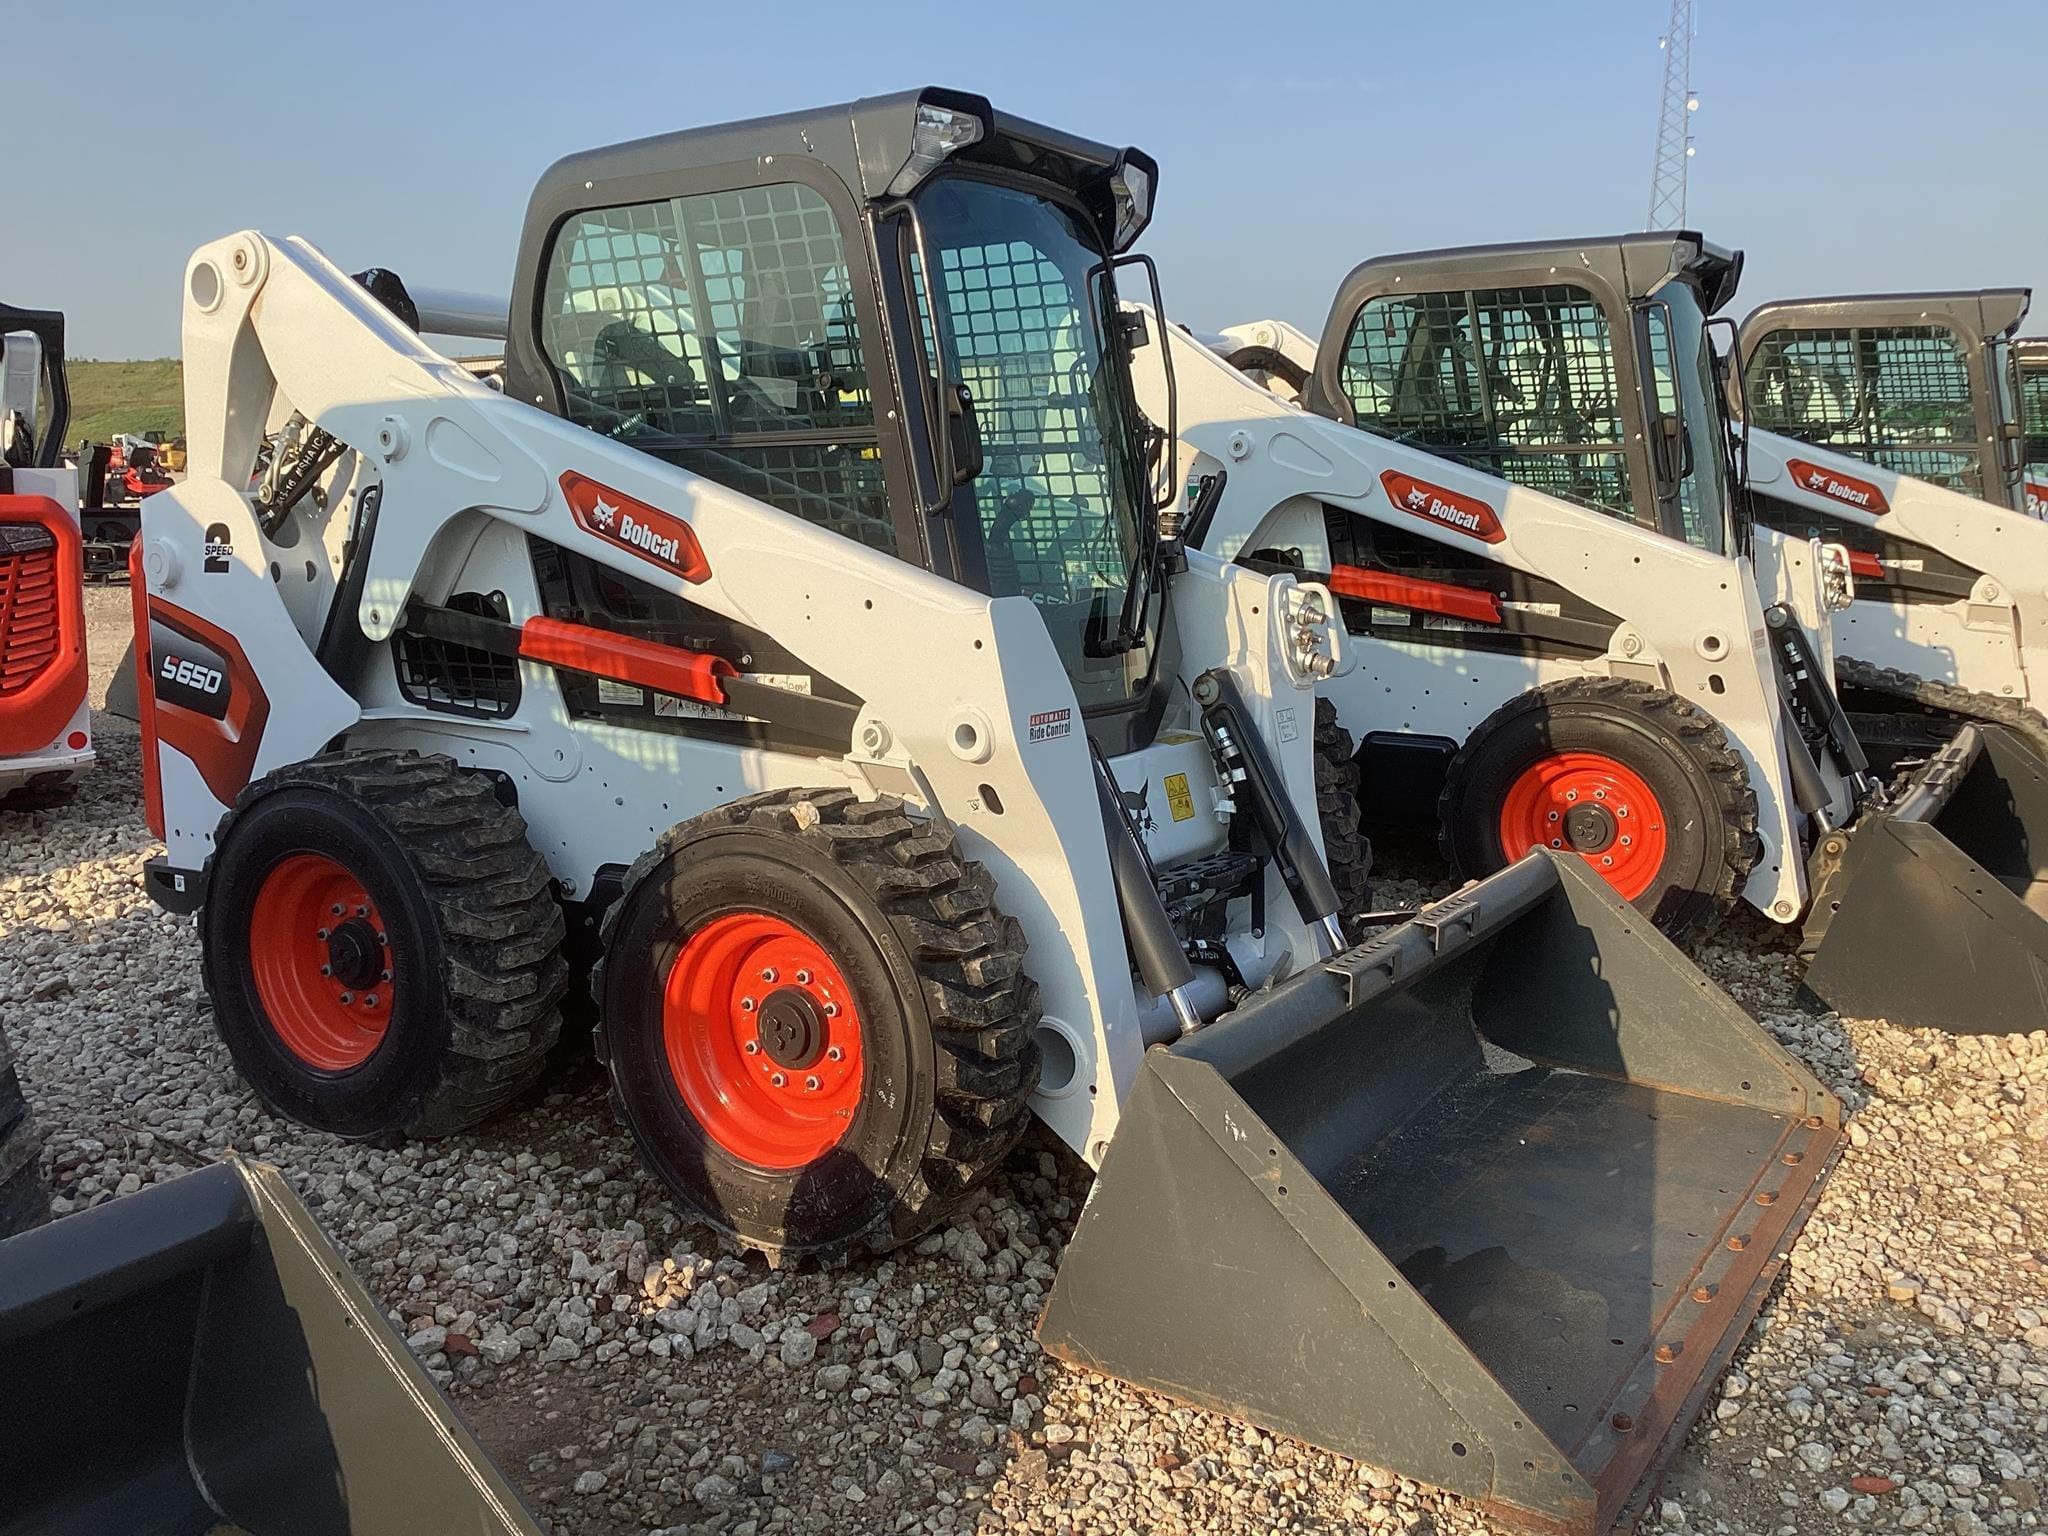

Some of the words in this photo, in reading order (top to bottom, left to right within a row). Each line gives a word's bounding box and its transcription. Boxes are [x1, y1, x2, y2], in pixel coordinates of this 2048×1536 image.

[1827, 481, 1869, 505] Bobcat
[1429, 498, 1480, 531] Bobcat
[204, 545, 234, 556] SPEED
[619, 514, 679, 563] Bobcat
[161, 656, 222, 694] S650
[1030, 724, 1045, 740] Ride
[1046, 720, 1070, 737] Control
[1031, 711, 1069, 725] AUTOMATIC
